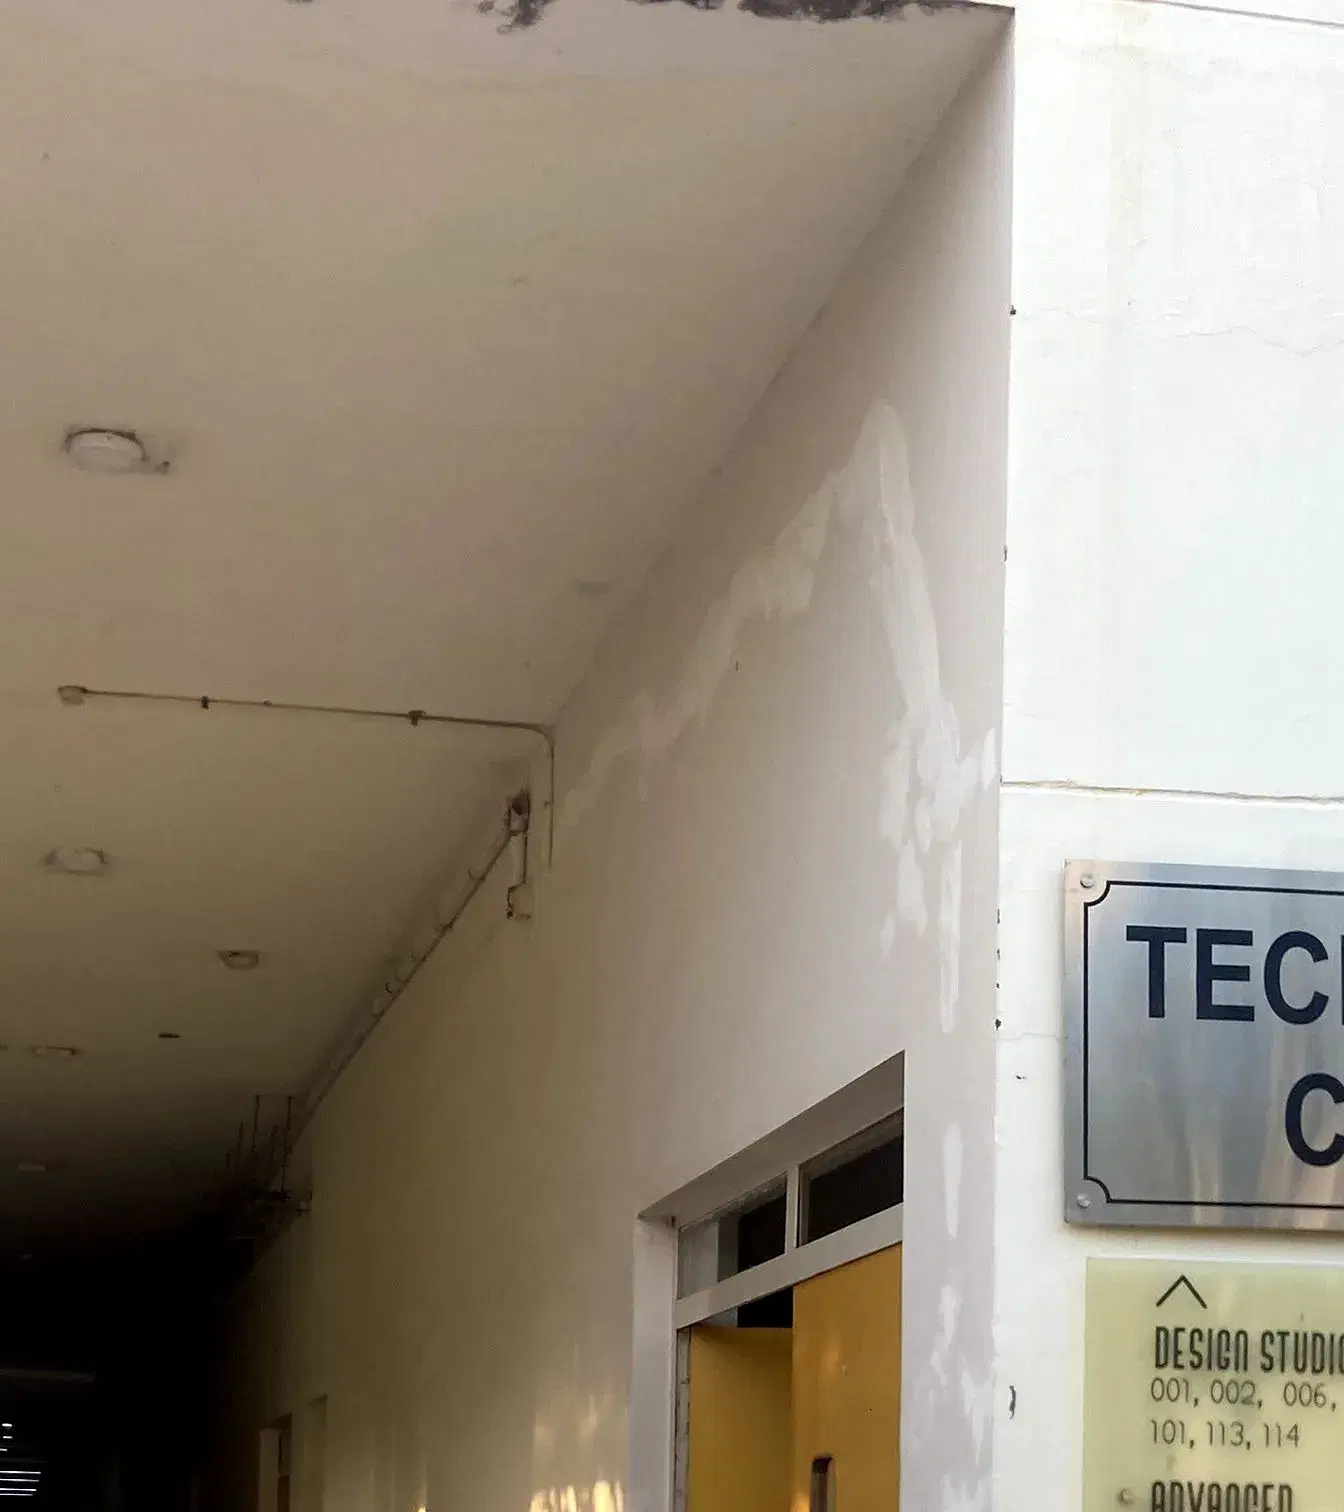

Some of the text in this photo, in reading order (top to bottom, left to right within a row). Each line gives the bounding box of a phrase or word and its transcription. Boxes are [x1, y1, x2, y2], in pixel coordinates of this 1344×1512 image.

[1155, 1325, 1249, 1373] DESIGN
[1150, 1377, 1337, 1412] 001, 002, 006,
[1151, 1419, 1300, 1451] 101, 113, 114
